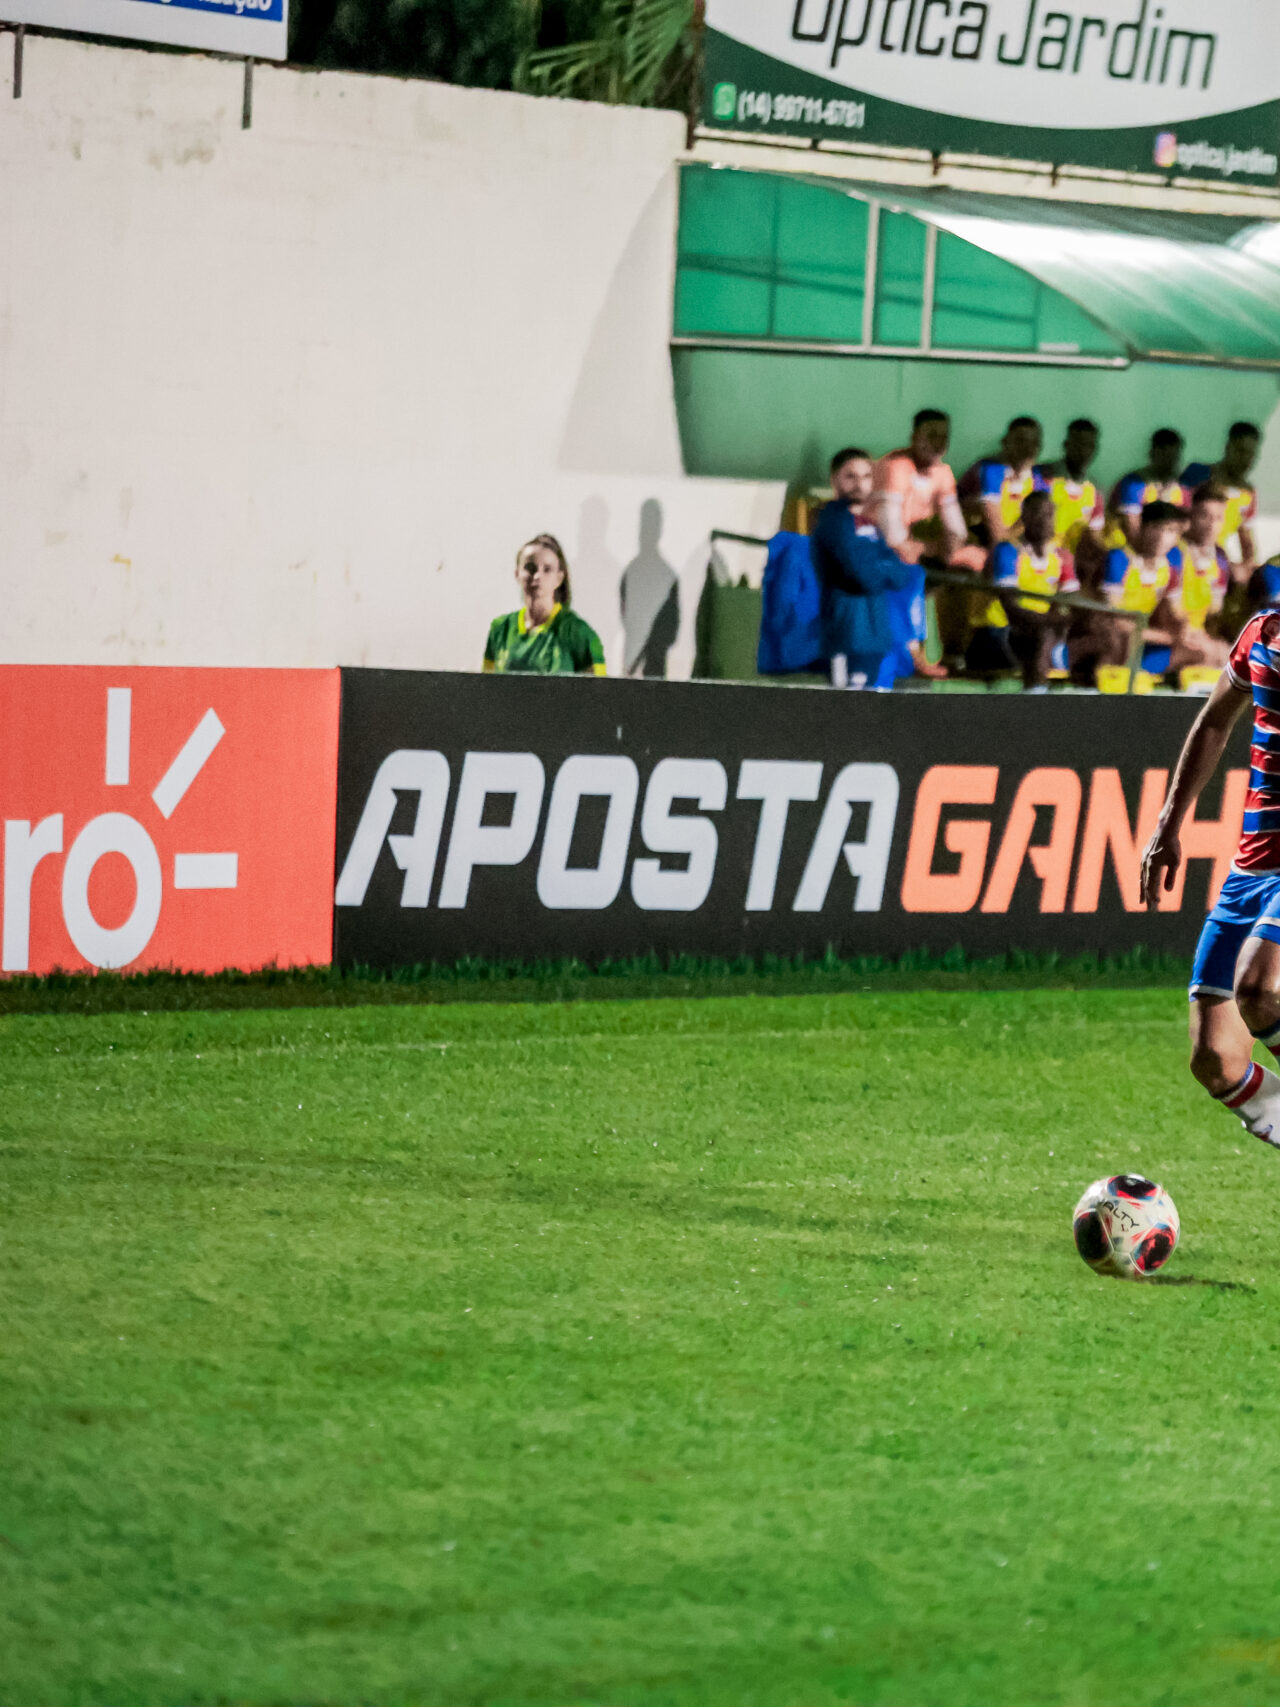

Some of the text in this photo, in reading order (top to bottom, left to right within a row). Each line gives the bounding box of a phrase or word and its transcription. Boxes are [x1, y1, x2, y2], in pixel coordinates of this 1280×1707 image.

[998, 0, 1218, 89] Jardim
[334, 749, 1250, 914] APOSTA GANH
